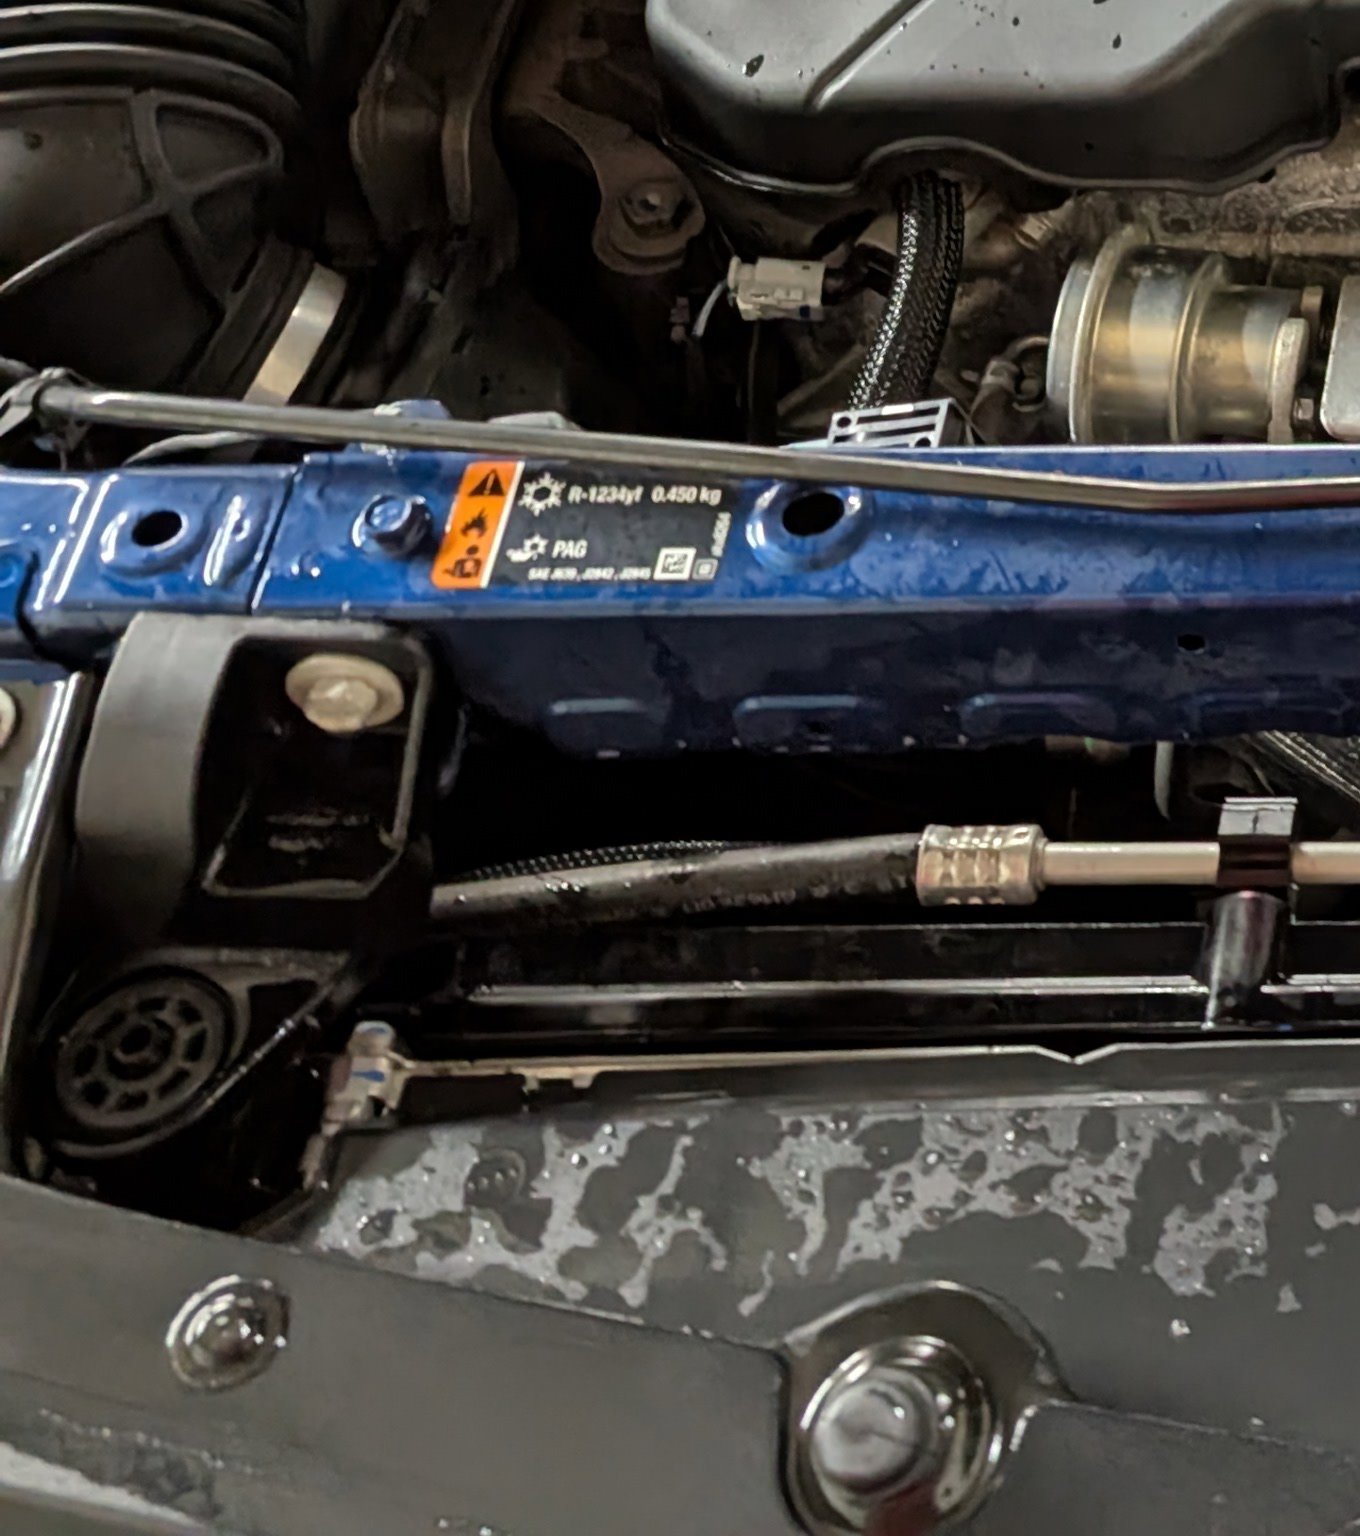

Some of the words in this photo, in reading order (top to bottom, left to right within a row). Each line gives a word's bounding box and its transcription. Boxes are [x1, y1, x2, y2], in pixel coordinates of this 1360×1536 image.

[567, 485, 643, 506] R-1234yf
[651, 486, 697, 504] 0.450
[699, 486, 722, 506] kg
[552, 539, 588, 559] PAG
